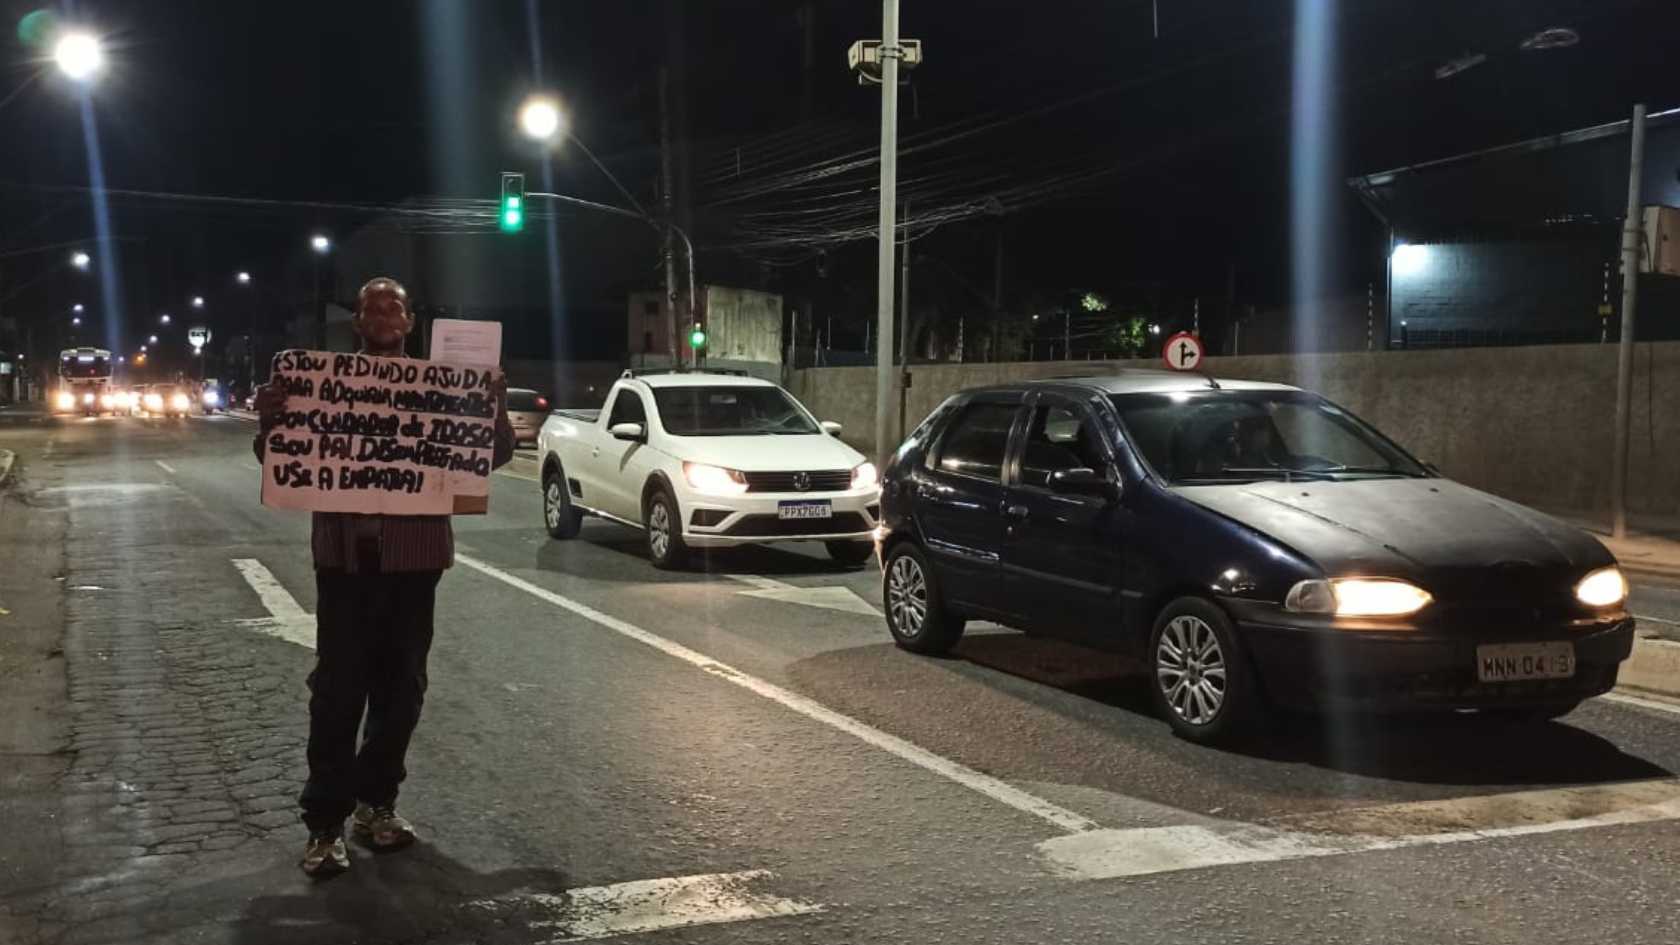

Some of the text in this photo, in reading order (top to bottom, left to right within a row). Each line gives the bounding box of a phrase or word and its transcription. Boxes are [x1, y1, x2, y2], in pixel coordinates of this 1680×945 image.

[273, 351, 327, 373] ESTOU
[422, 366, 491, 391] AJUDA
[318, 466, 333, 491] A
